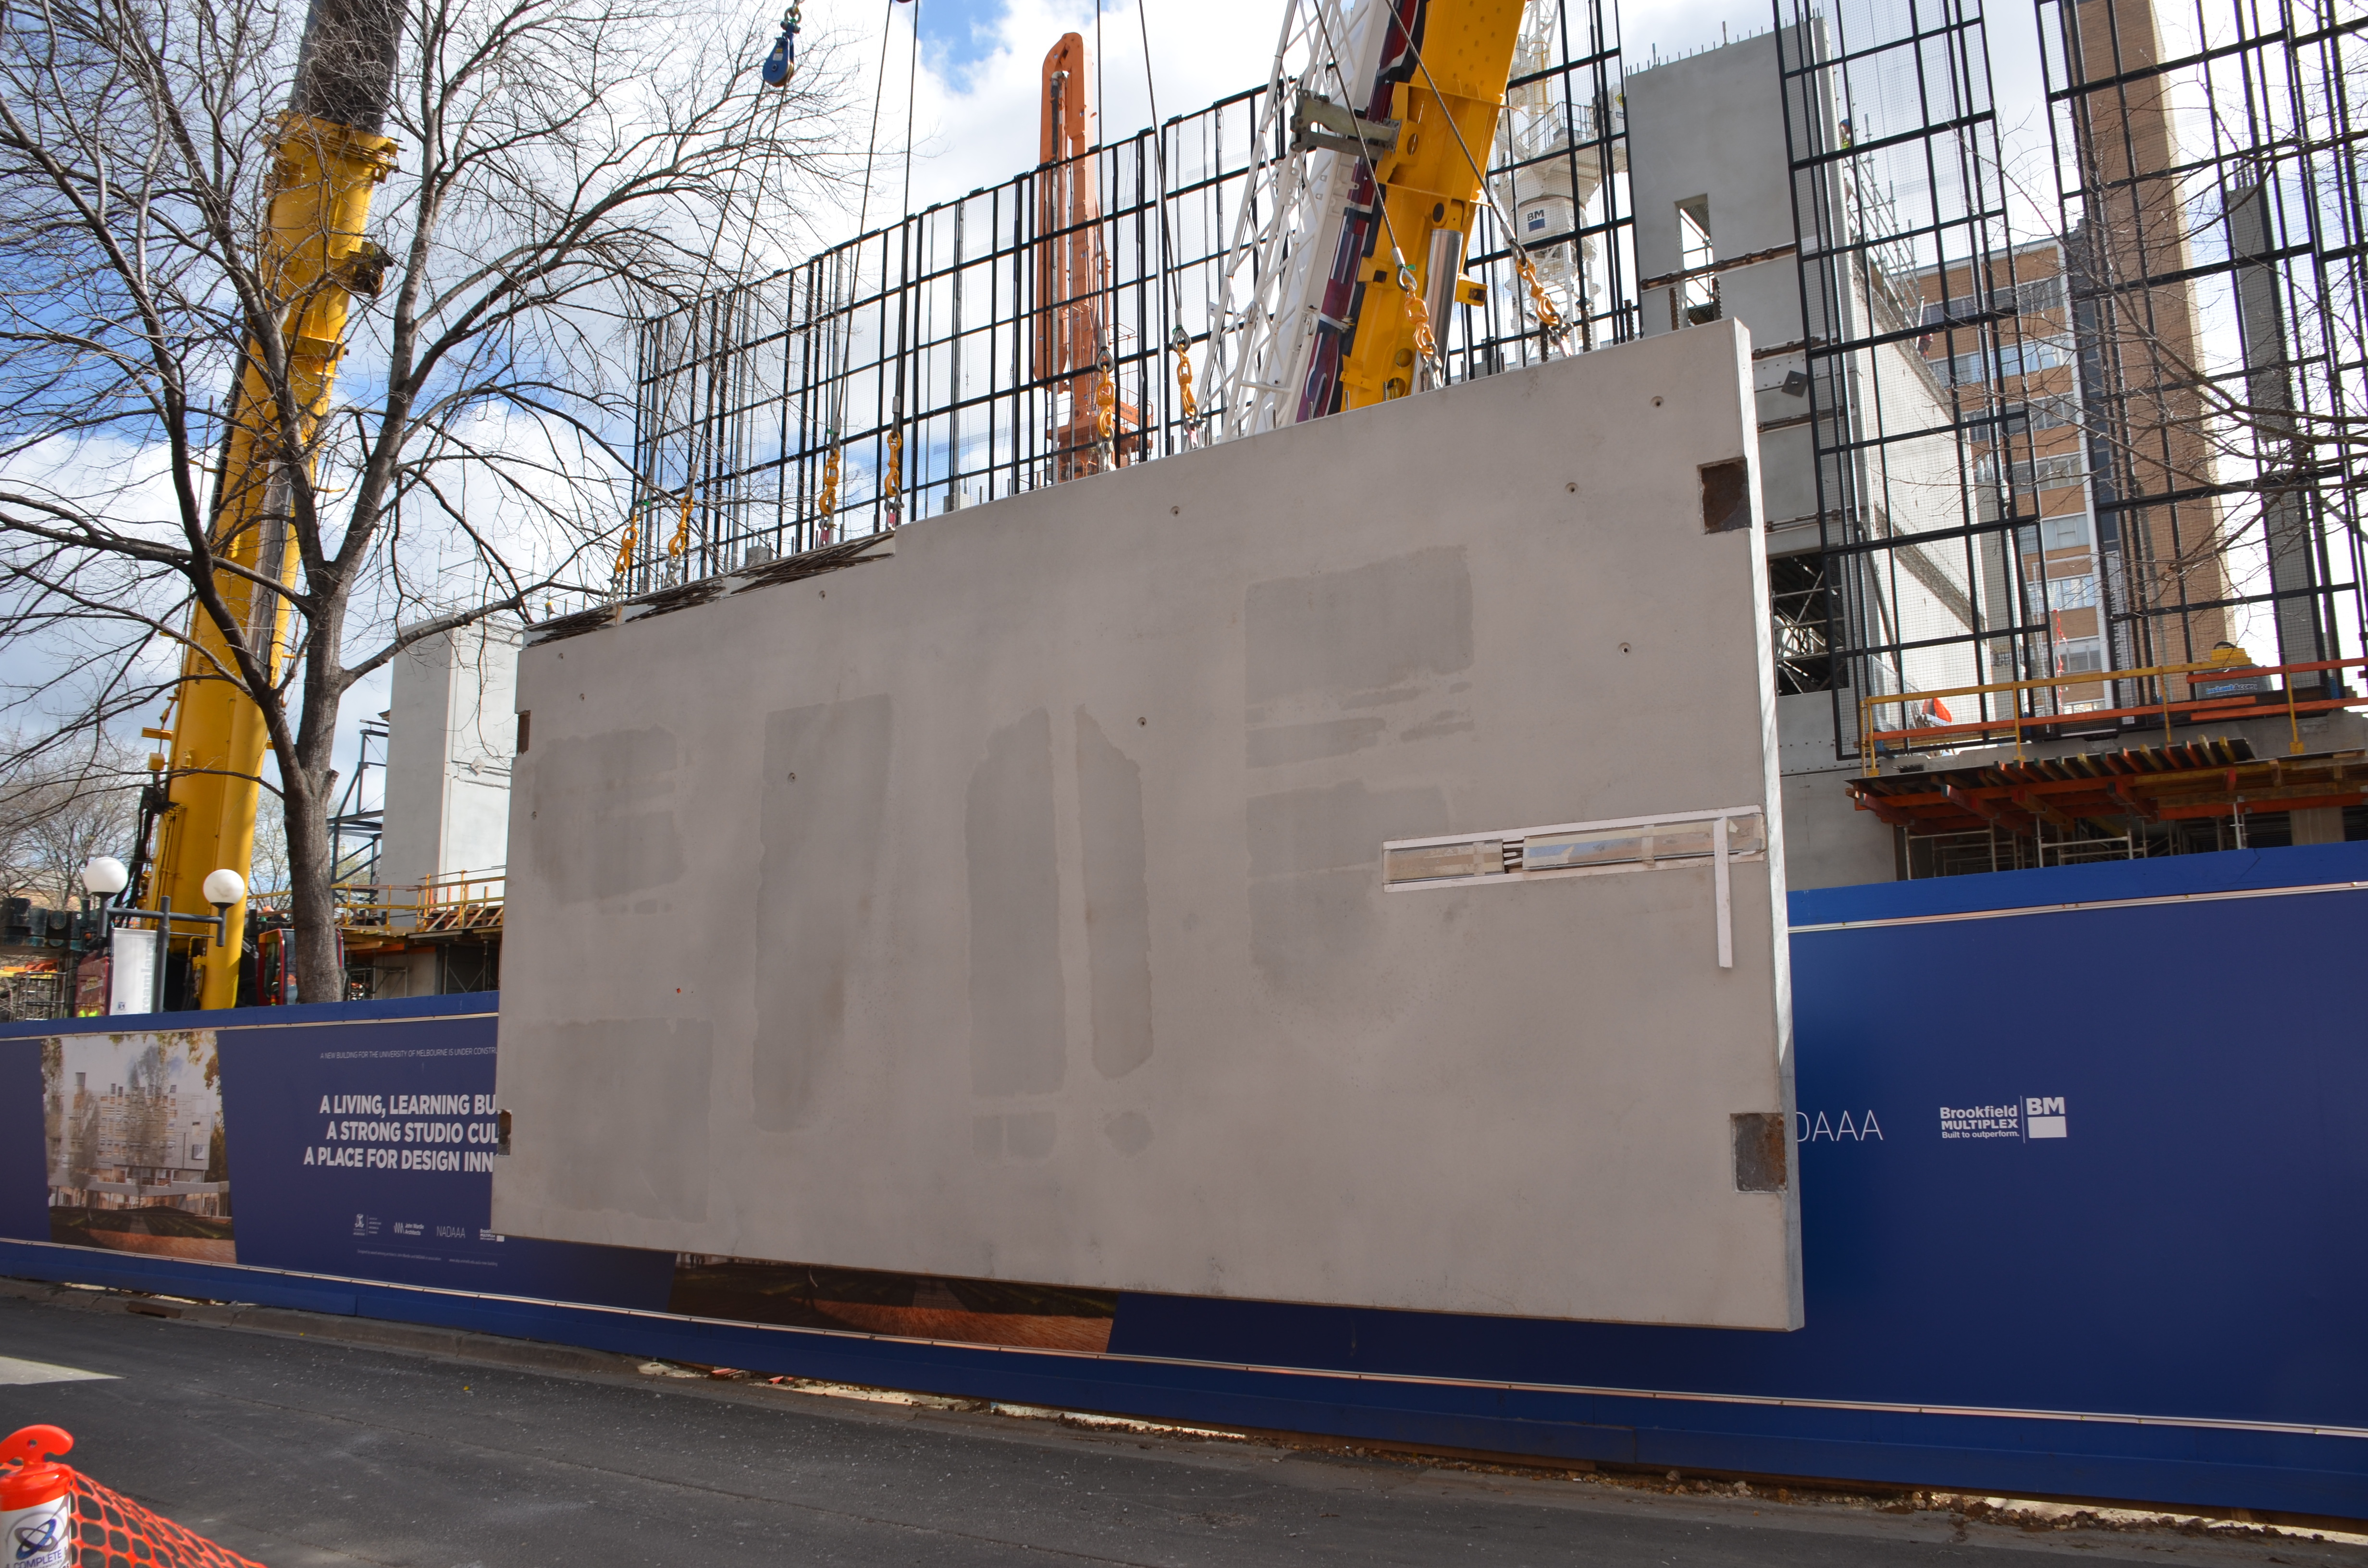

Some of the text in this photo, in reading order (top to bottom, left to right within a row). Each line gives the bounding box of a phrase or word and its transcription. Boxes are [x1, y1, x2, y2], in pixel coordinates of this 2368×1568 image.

[1527, 209, 1544, 221] BM
[319, 1094, 499, 1118] A LIVING, LEARNING BU
[1940, 1105, 2018, 1119] Brookfield
[2026, 1097, 2065, 1115] BM
[1941, 1119, 2019, 1130] MULTIPLEX
[326, 1121, 337, 1140] A
[340, 1121, 401, 1142] STRONG
[404, 1122, 464, 1143] STUDIO
[1972, 1130, 2020, 1139] outperform.
[303, 1146, 315, 1165] A
[318, 1147, 364, 1167] PLACE
[367, 1149, 398, 1169] FOR
[401, 1150, 460, 1171] DESIGN
[436, 1225, 466, 1238] NADAAA
